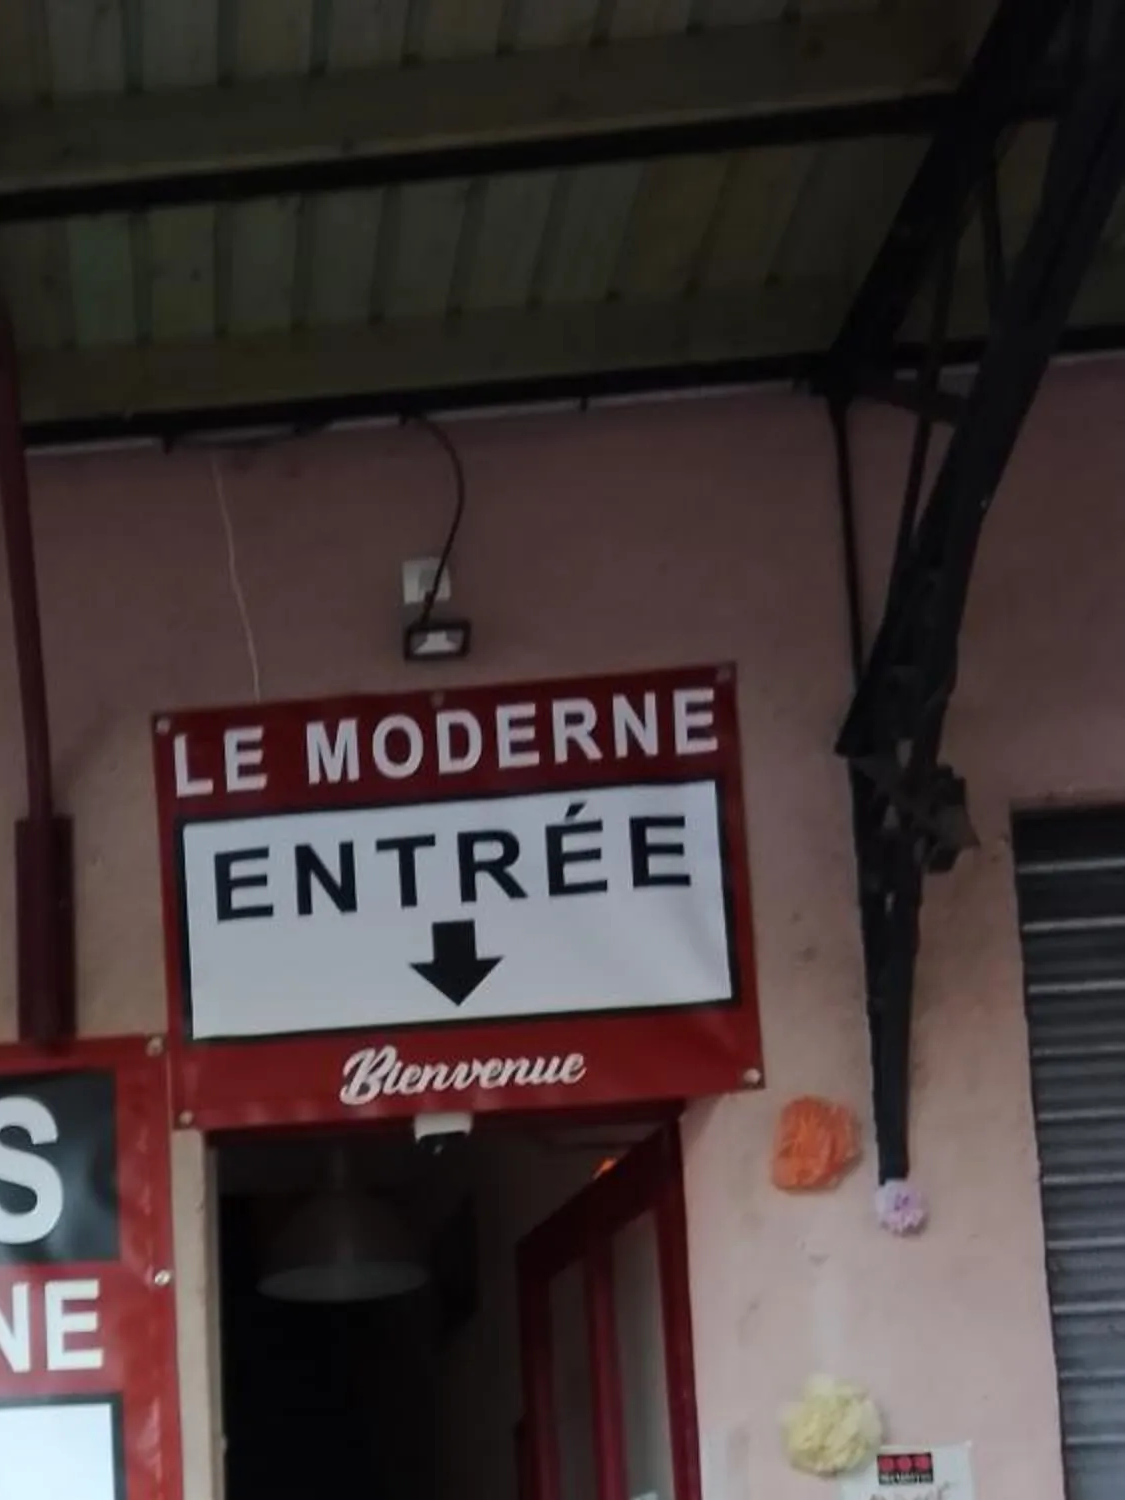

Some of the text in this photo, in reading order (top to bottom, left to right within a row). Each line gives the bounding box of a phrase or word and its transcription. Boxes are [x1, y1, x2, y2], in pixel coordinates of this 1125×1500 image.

[175, 688, 718, 797] LE MODERNE
[214, 802, 692, 921] ENTRÉE
[340, 1045, 586, 1105] Bienvenue
